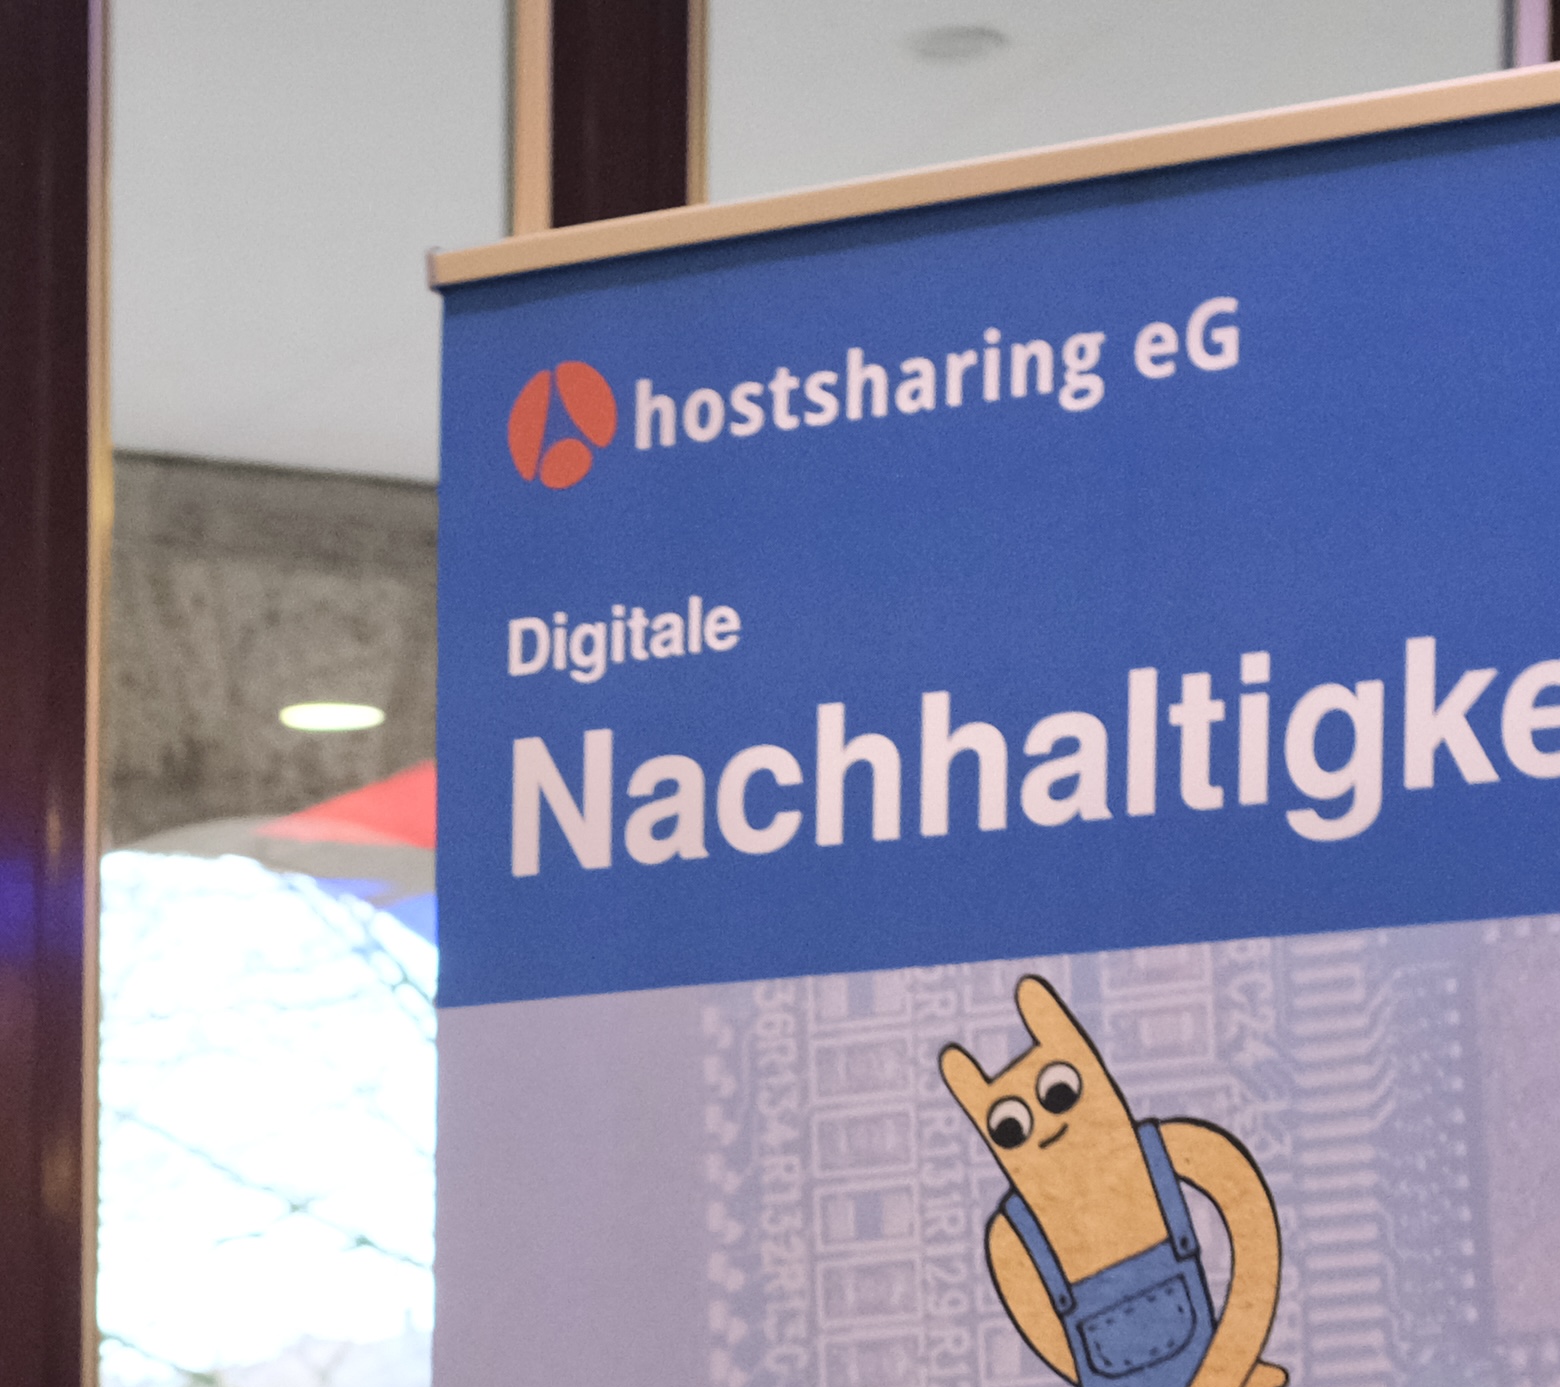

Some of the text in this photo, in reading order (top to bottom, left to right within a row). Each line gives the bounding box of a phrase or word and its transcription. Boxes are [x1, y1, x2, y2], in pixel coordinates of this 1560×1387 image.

[634, 296, 1242, 451] hostsharing eG
[507, 594, 742, 684] Digitale
